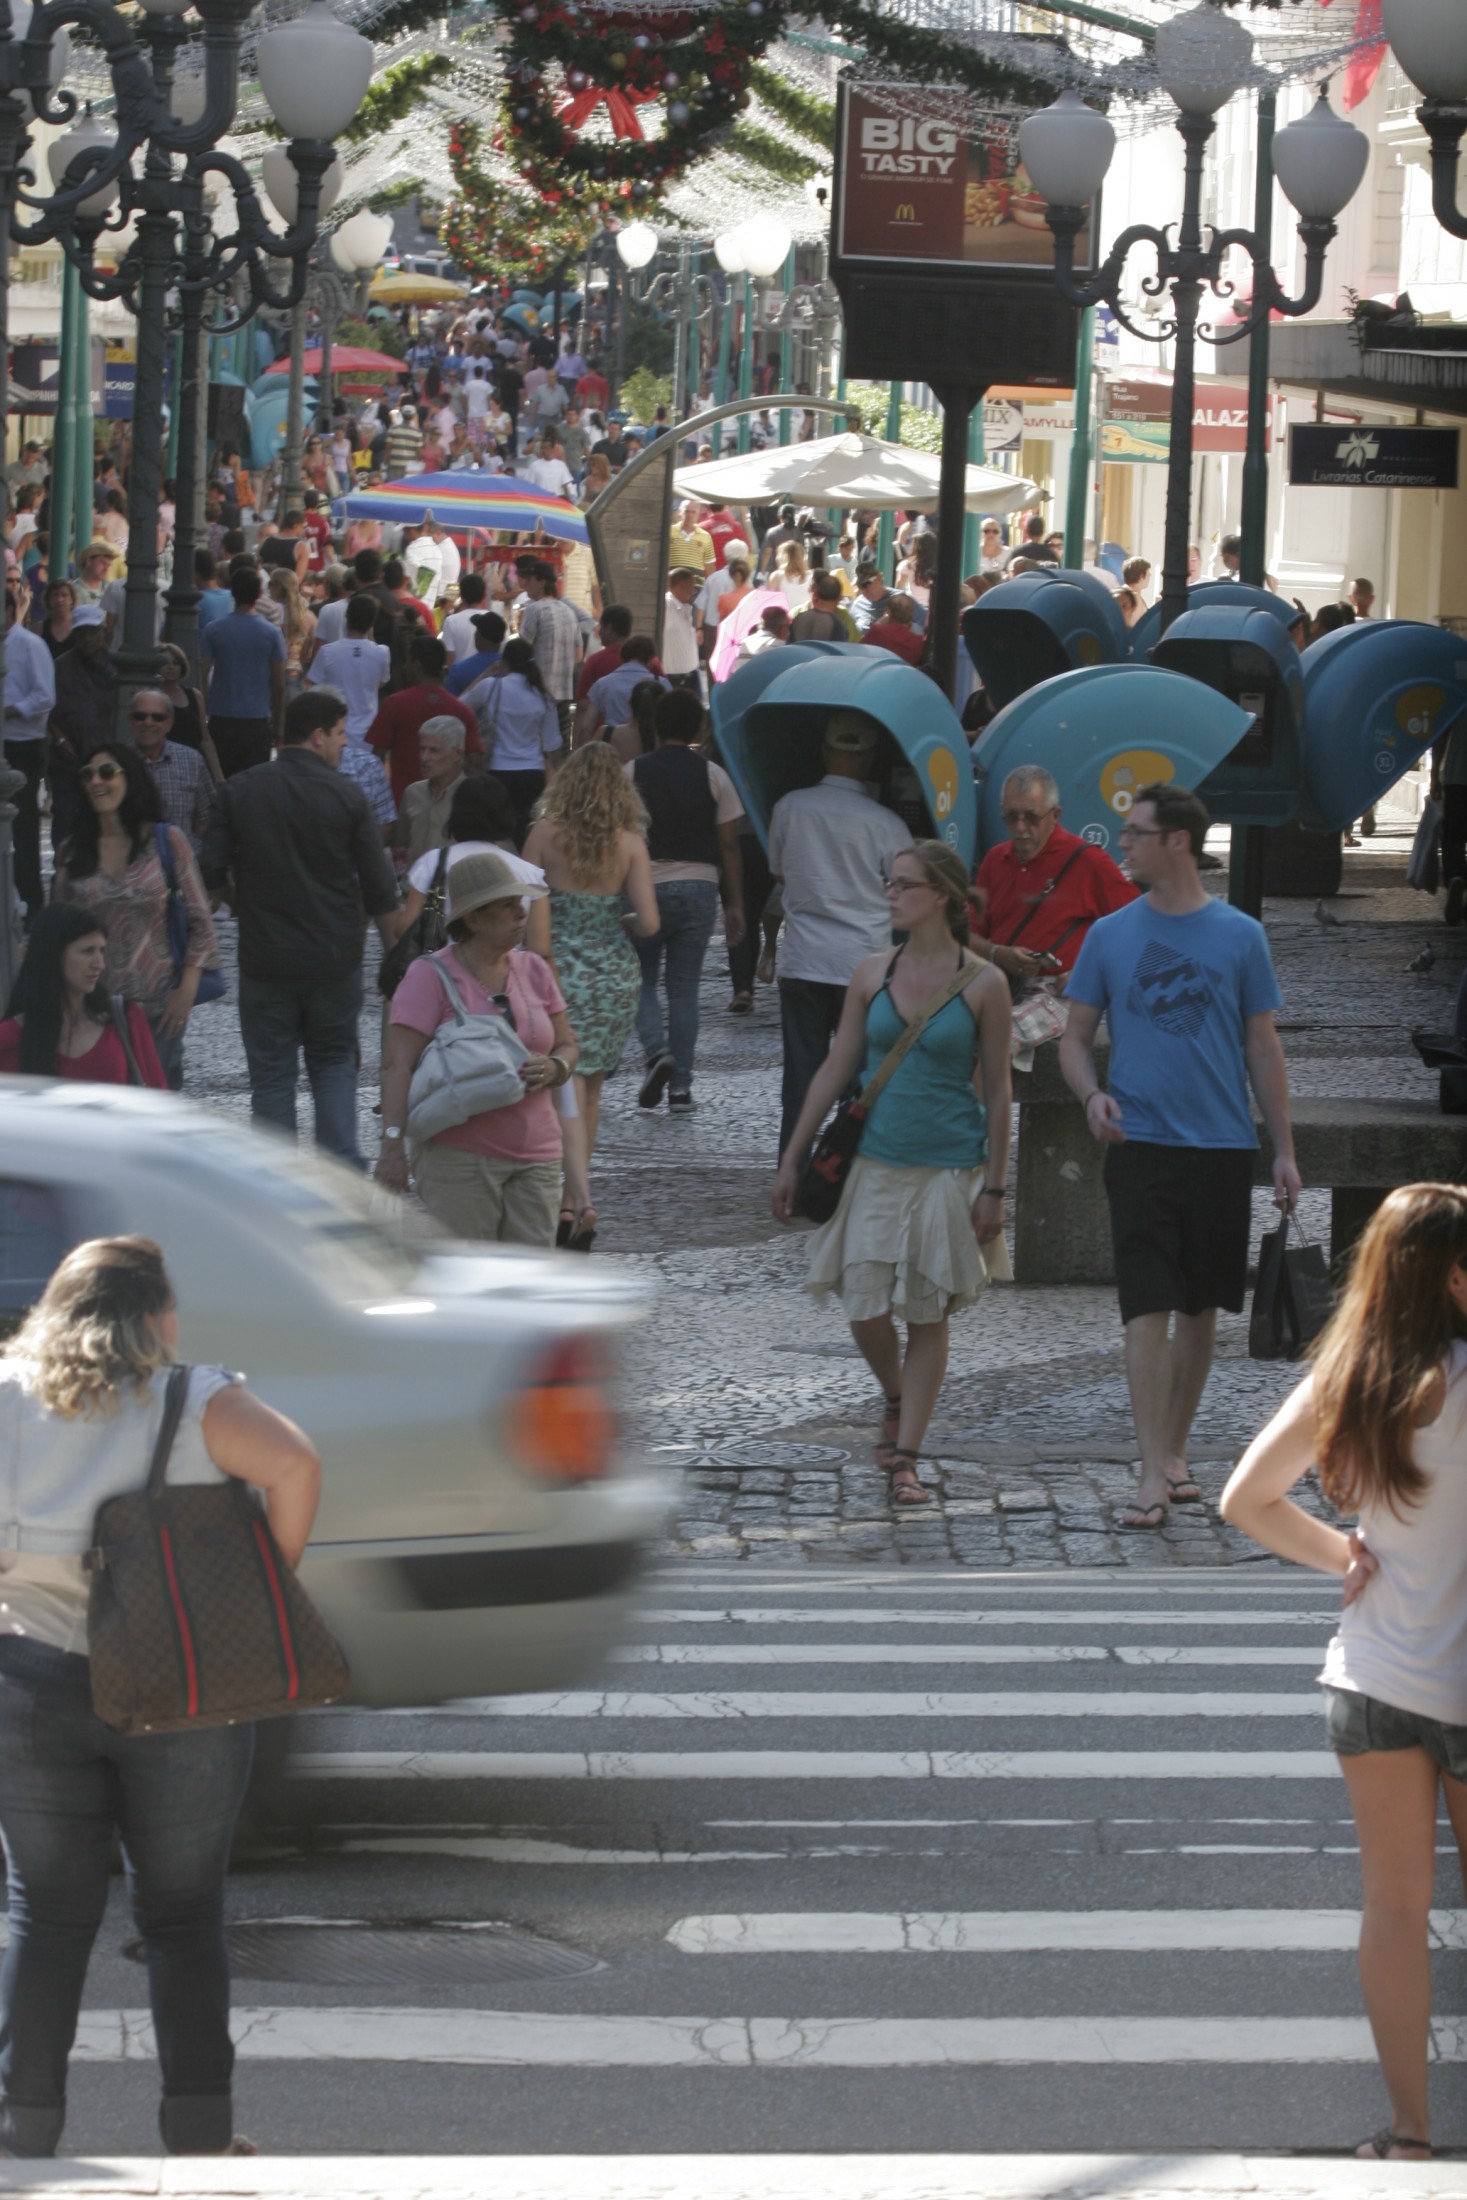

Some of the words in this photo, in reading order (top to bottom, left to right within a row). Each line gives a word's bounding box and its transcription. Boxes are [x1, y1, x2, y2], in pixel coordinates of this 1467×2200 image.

[862, 117, 957, 153] BIG
[861, 152, 956, 175] TASTY
[1192, 408, 1272, 428] ALAZ
[1312, 468, 1361, 483] Livrarias
[1364, 470, 1437, 485] Catarinense
[1408, 710, 1429, 734] oi
[938, 781, 952, 813] oi
[1112, 784, 1143, 813] o
[1088, 831, 1102, 845] 31
